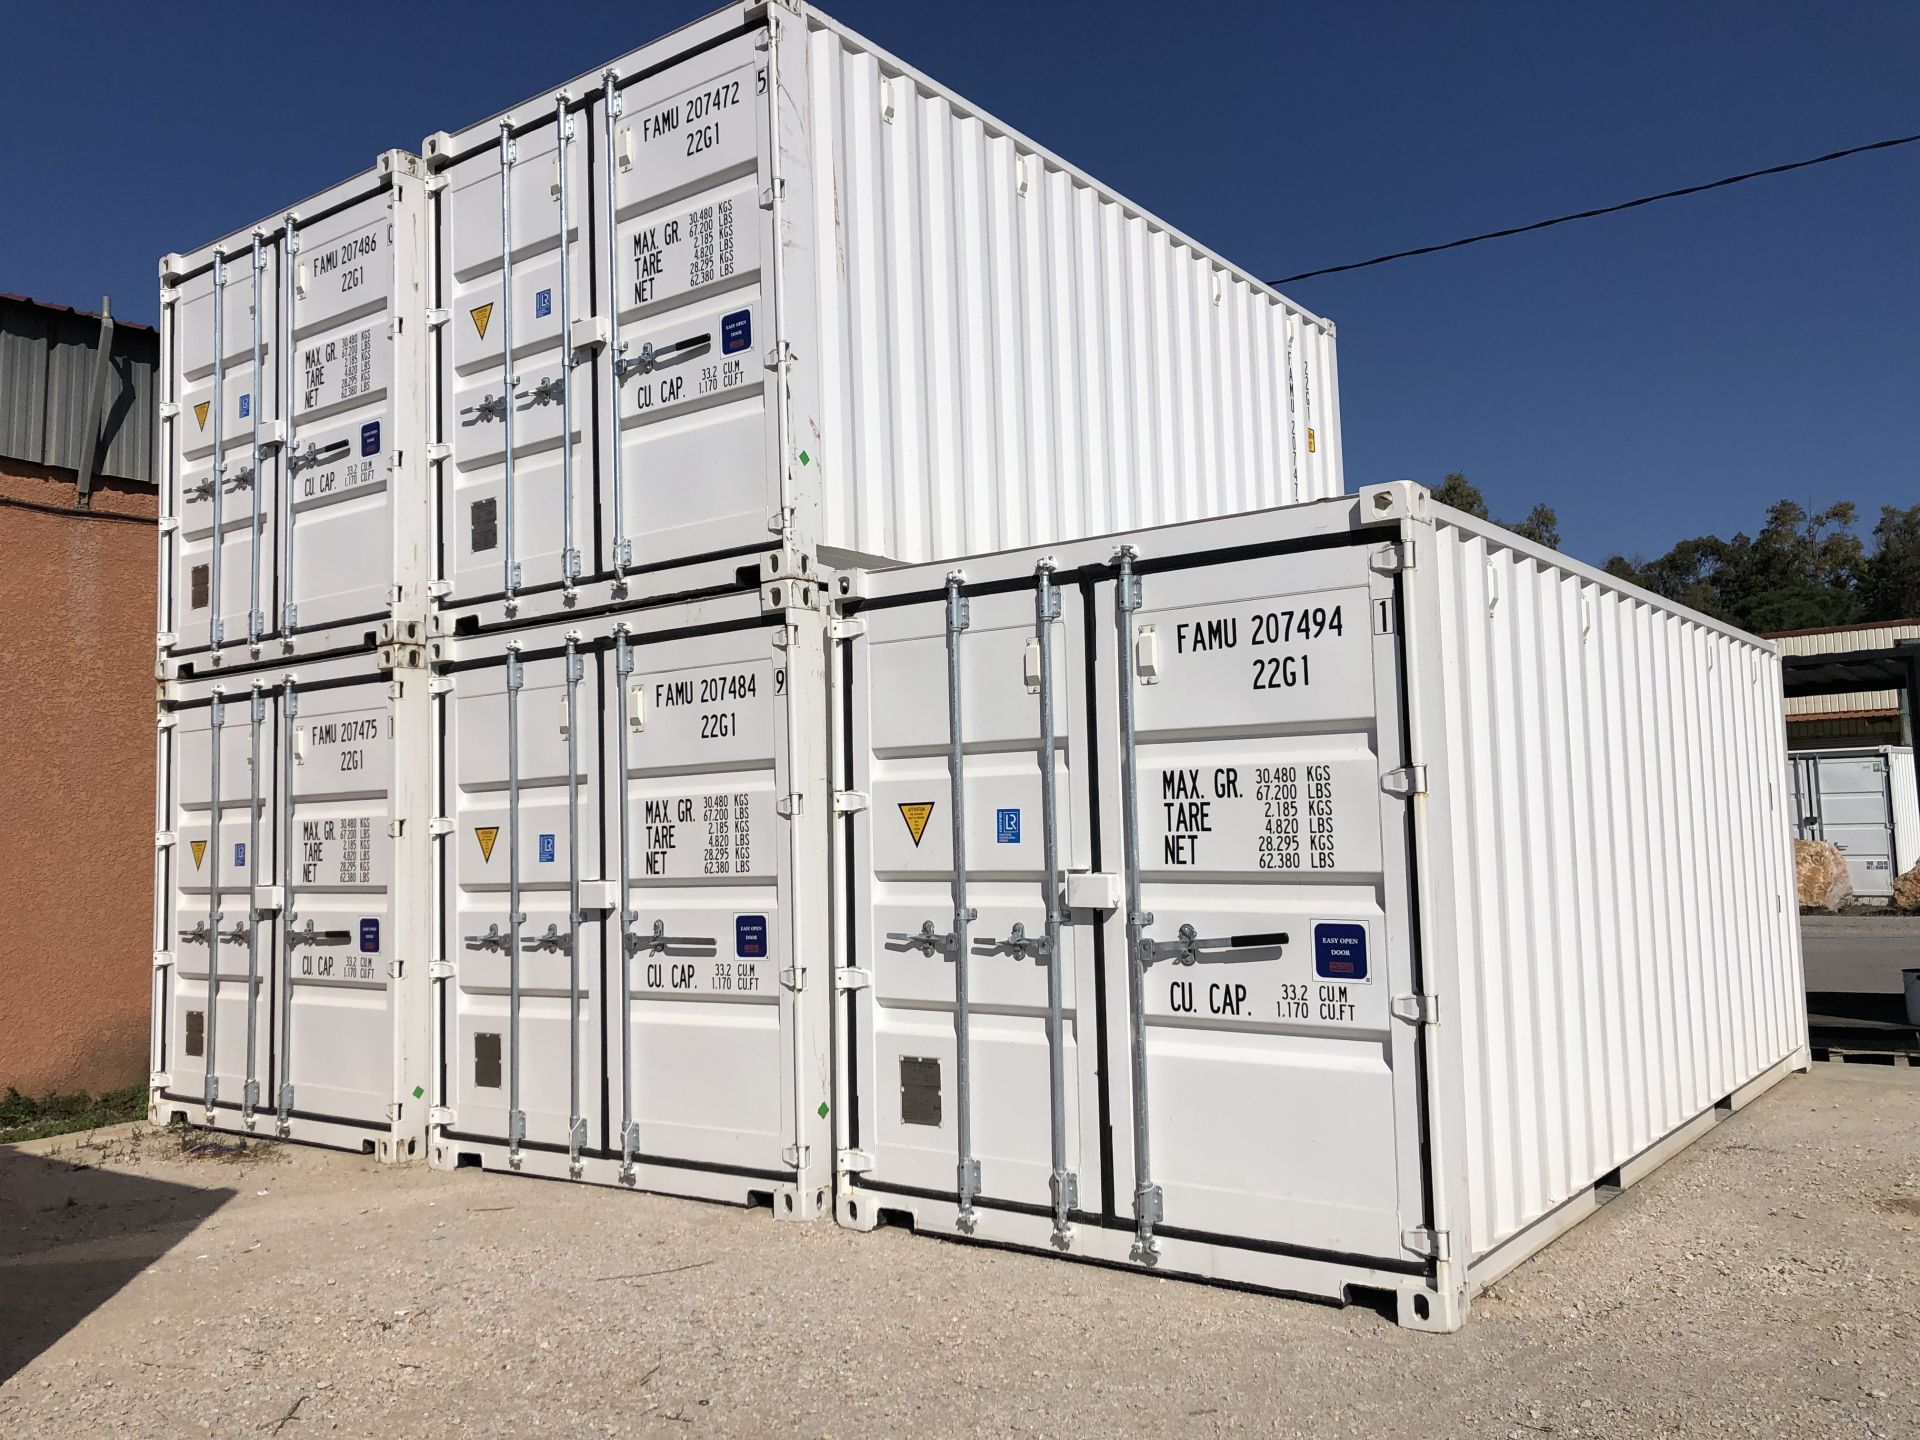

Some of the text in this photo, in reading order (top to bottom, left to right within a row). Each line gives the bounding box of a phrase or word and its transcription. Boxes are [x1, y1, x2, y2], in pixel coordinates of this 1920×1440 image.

[644, 69, 767, 142] FAMU 207472 5
[686, 122, 720, 157] 22G1
[719, 199, 733, 215] KGS
[719, 212, 733, 227] LBS
[634, 220, 682, 256] MAX. GR.
[719, 224, 733, 239] KGS
[314, 250, 338, 277] FAMU
[341, 232, 377, 265] 207486
[720, 237, 734, 252] LBS
[634, 250, 663, 280] TARE
[720, 249, 734, 264] KGS
[342, 266, 363, 292] 22G1
[720, 262, 734, 277] LBS
[634, 277, 654, 304] NET
[638, 376, 686, 409] CU. CAP.
[1176, 600, 1388, 654] FAMU 207494 1
[1253, 654, 1309, 690] 22G1
[656, 670, 785, 708] FAMU 207484 9
[312, 724, 337, 746] FAMU
[341, 719, 377, 742] 207475
[701, 712, 736, 739] 22G1
[341, 750, 363, 771] 22G1
[1162, 768, 1243, 800] MAX. GR.
[1307, 765, 1330, 782] KGS
[734, 793, 748, 806] KGS
[1308, 782, 1332, 799] LBS
[646, 799, 696, 824] MAX. GR.
[735, 807, 749, 820] LBS
[1163, 802, 1212, 832] TARE
[1309, 800, 1332, 816] KGS
[735, 820, 750, 833] KGS
[1310, 817, 1333, 834] LBS
[646, 825, 676, 850] TARE
[735, 833, 750, 846] LBS
[1310, 834, 1334, 851] KGS
[735, 847, 750, 860] KGS
[1164, 835, 1198, 865] NET
[1311, 852, 1335, 868] LBS
[646, 851, 667, 875] NET
[736, 860, 750, 873] LBS
[647, 964, 698, 989] CU. CAP.
[1170, 982, 1252, 1016] CU. CAP.
[1281, 984, 1347, 1003] 33.2 CU.M
[1320, 1003, 1355, 1021] CU.FT
